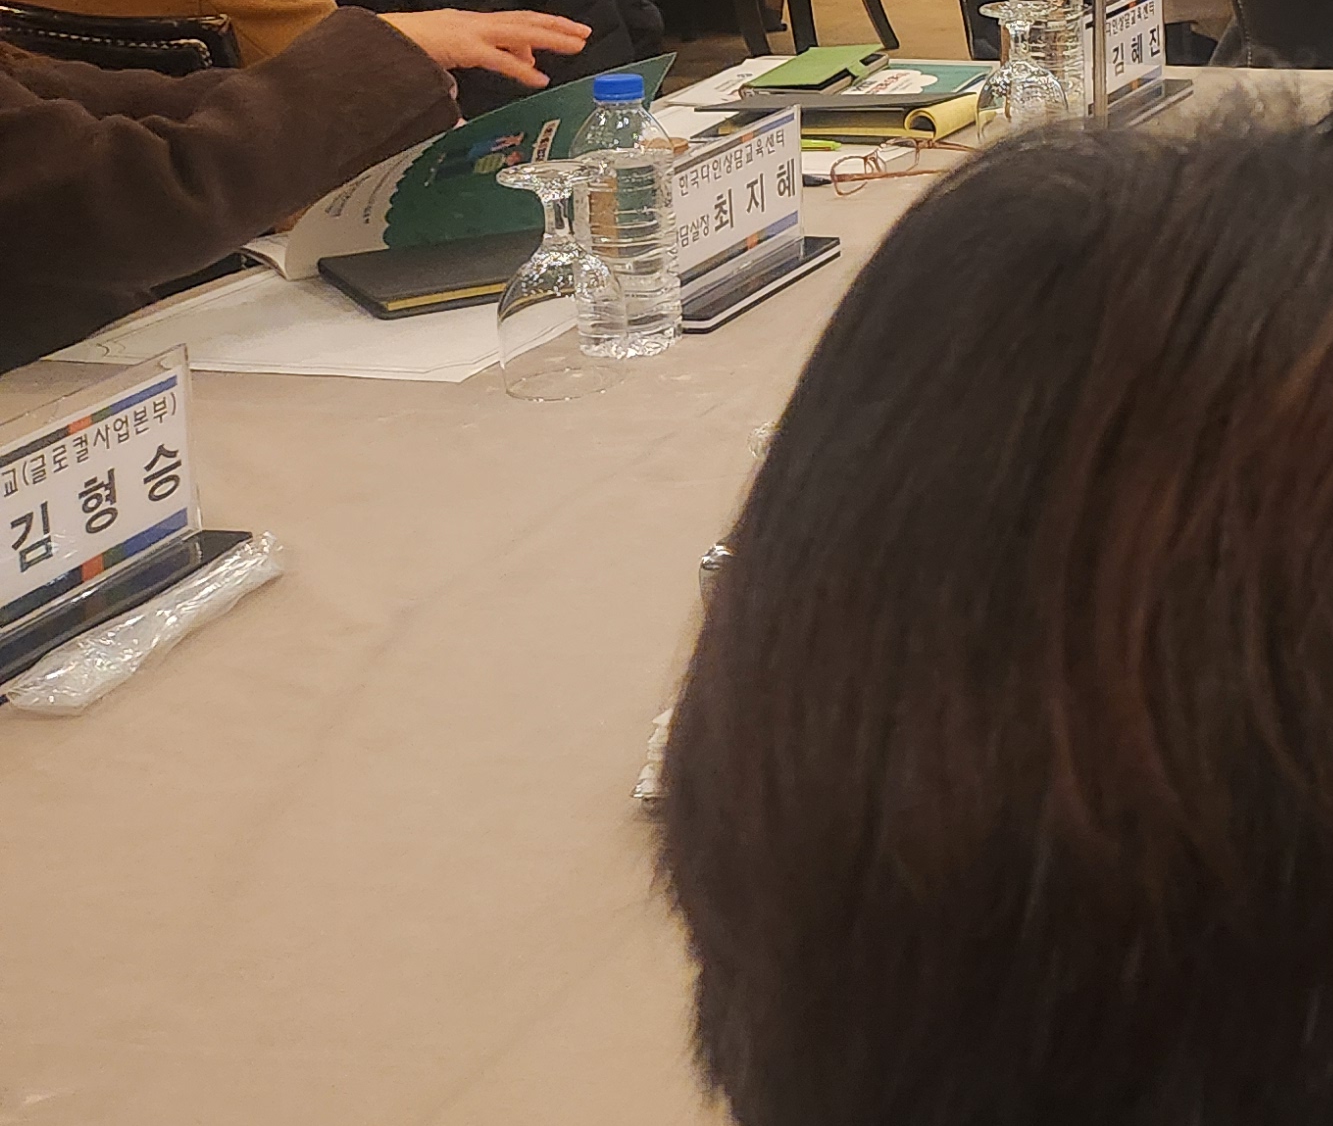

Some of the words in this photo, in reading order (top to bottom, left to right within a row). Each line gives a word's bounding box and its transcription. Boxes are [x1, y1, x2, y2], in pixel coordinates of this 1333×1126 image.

[1112, 42, 1125, 77] 김
[1131, 32, 1143, 64] 혜
[1149, 24, 1161, 58] 진
[678, 127, 785, 198] 한국다인상담교육센터
[675, 213, 710, 248] 담실장
[714, 188, 734, 233] 최
[746, 172, 766, 214] 지
[776, 158, 796, 199] 혜
[10, 500, 54, 573] 김
[78, 467, 119, 535] 형
[143, 443, 183, 503] 승
